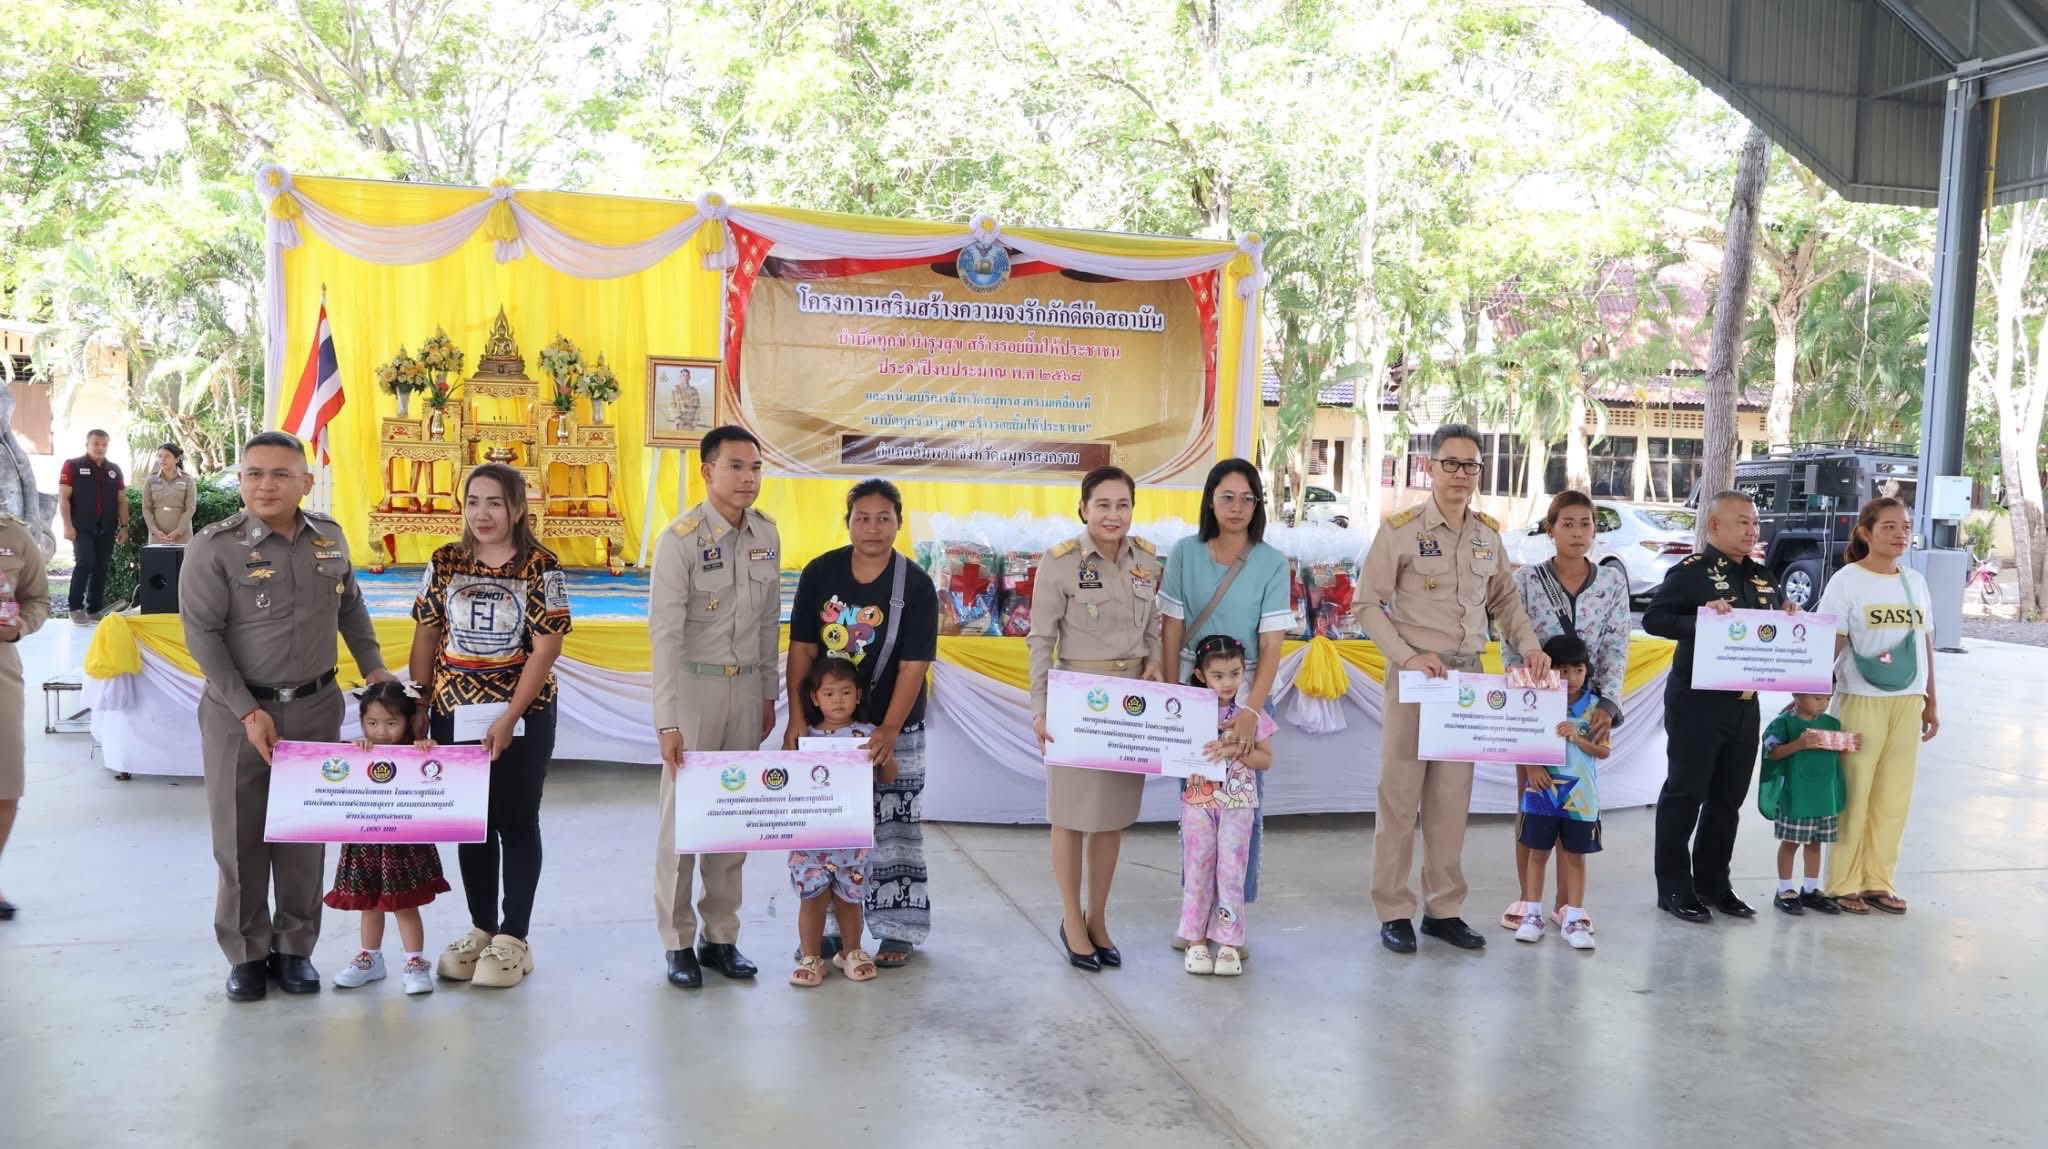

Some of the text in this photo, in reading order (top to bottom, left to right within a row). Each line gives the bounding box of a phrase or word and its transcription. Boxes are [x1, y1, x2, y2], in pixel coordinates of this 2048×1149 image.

[797, 285, 1163, 330] โครงการเสริมสร้างความจงรักภักดีต่อสถาบัน
[839, 330, 1120, 358] บำบัดทุกข์ บำรุงสุข สร้างรอยยิ้มให้ประชาชน
[879, 358, 1006, 378] ประจำปีงบประมาณ
[1039, 368, 1082, 382] ๒๕๖๘
[865, 389, 1092, 409] และหน่วยบริการจังหวัดสมุทรสงครามเคลื่อนที่
[876, 442, 1080, 466] อำเภออัมพวา จังหวัดสมุทรสงคราม
[467, 591, 504, 600] FENDI
[1870, 608, 1924, 625] SASSY
